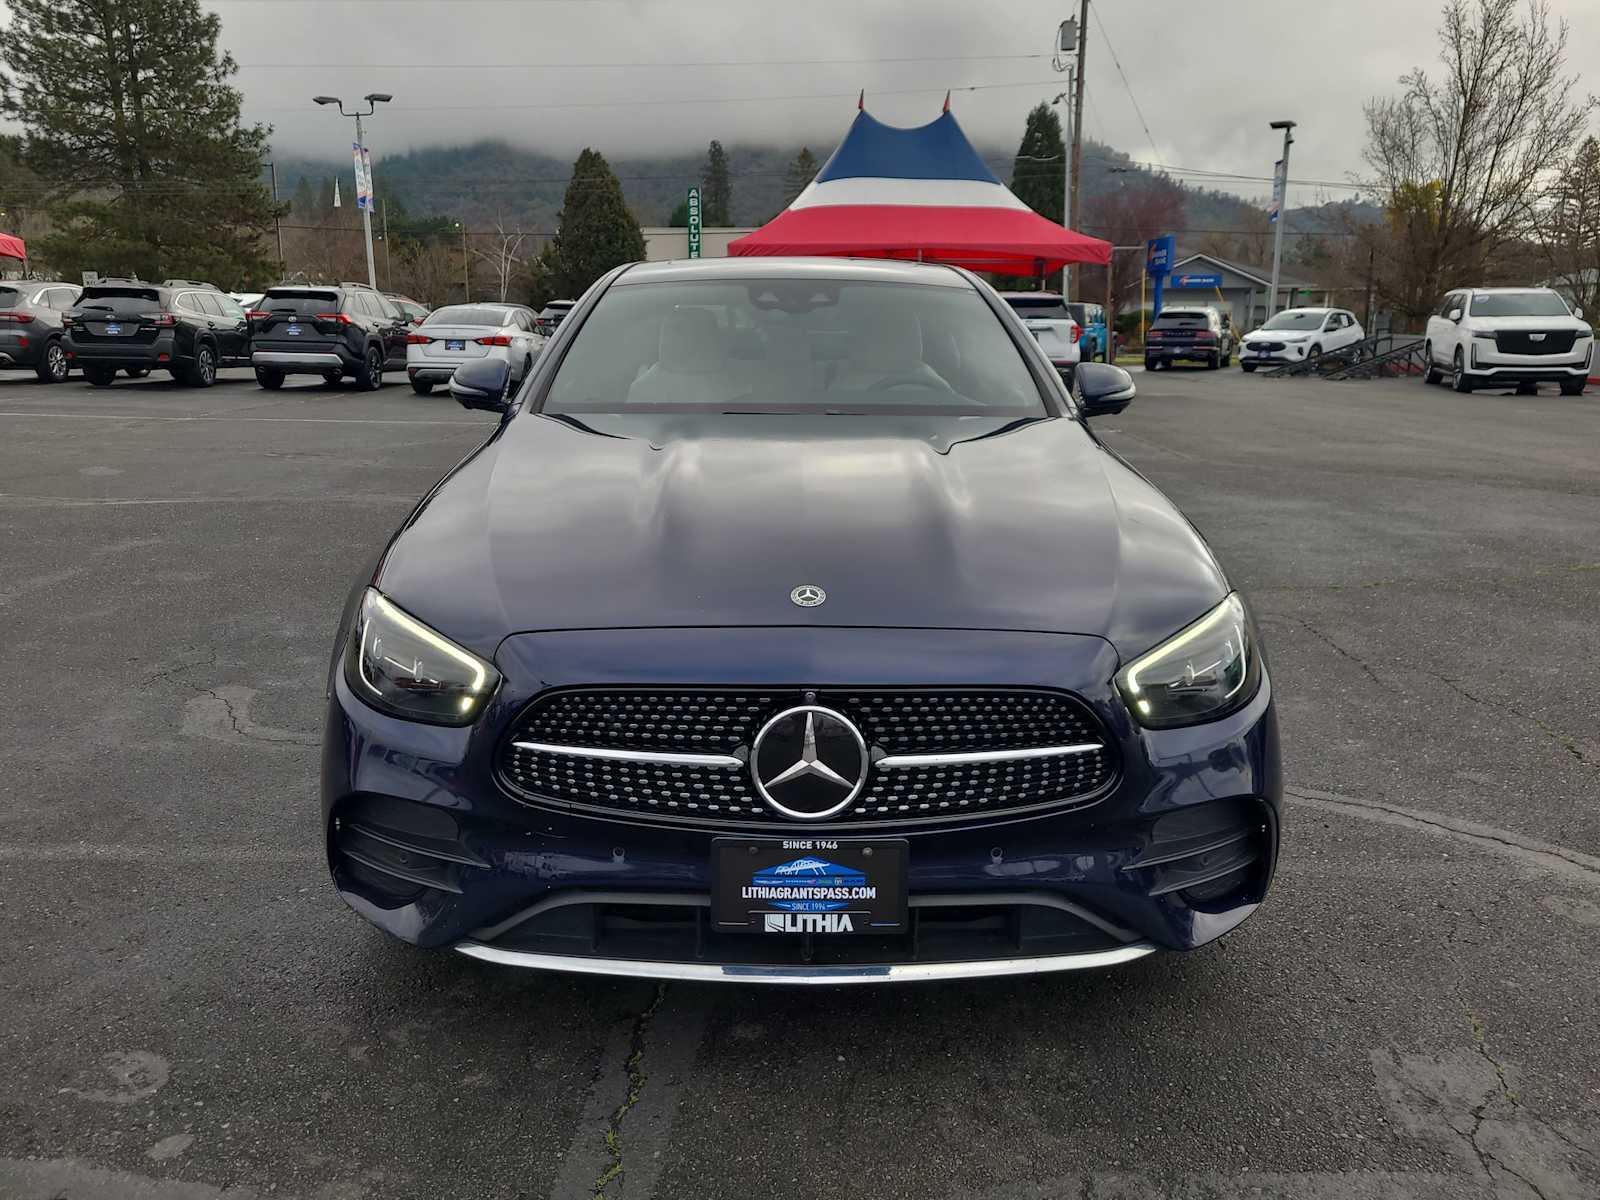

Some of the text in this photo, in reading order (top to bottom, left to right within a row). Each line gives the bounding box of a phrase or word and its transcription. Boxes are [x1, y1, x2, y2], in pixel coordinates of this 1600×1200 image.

[688, 189, 699, 259] ABSOLUTE
[782, 840, 839, 850] SINCE 1946
[741, 886, 876, 900] LITHIAGRANTSPASS.COM
[791, 902, 810, 912] SINCE
[785, 913, 854, 933] LITHIA
